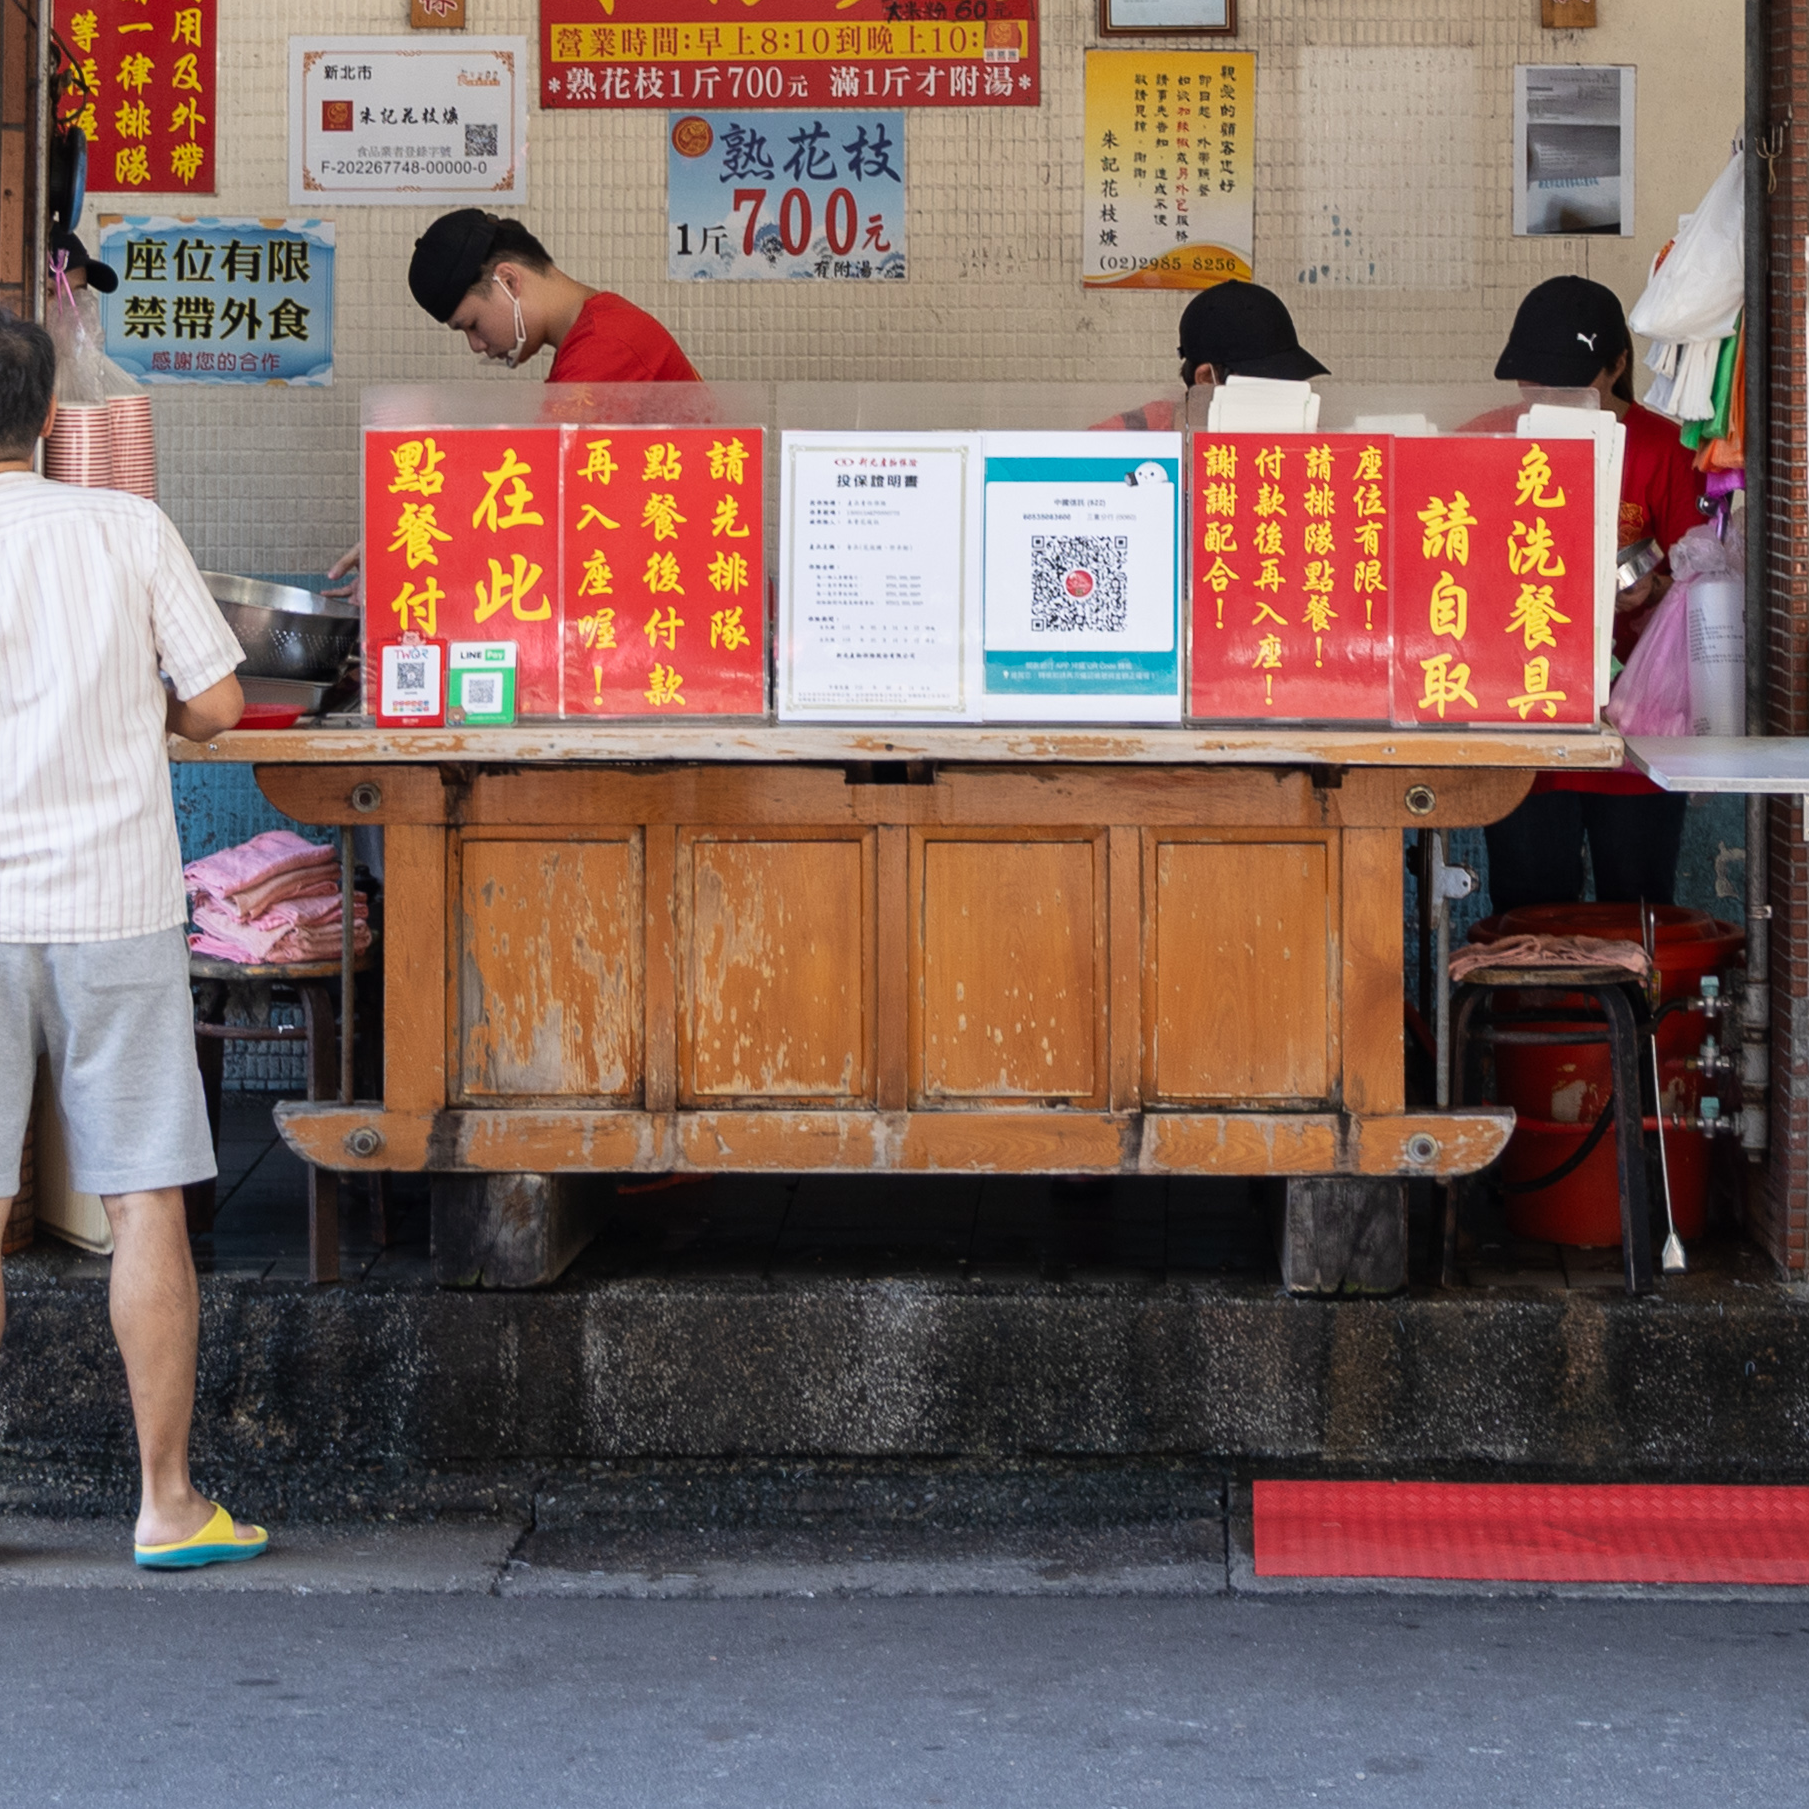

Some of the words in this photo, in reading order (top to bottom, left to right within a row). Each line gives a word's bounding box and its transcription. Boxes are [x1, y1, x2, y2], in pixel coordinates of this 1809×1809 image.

[557, 24, 1022, 57] 營業時間:早上8:10到晚上10:
[324, 65, 372, 80] 新北市
[321, 161, 487, 175] F-202267748-00000-0
[719, 121, 901, 183] 熟花枝
[124, 238, 311, 284] 座位有限
[1100, 256, 1182, 271] (02)2985
[1192, 256, 1236, 271] 8256
[123, 296, 311, 343] 禁帶外食
[151, 350, 282, 373] 感謝您的合作
[837, 474, 918, 488] 投保證明書
[472, 448, 552, 624] 在此
[705, 437, 751, 651] 請先排隊
[641, 442, 687, 707] 點餐後付款
[1505, 443, 1571, 720] 免洗餐具
[1416, 490, 1478, 718] 請自取
[460, 651, 482, 659] LINE
